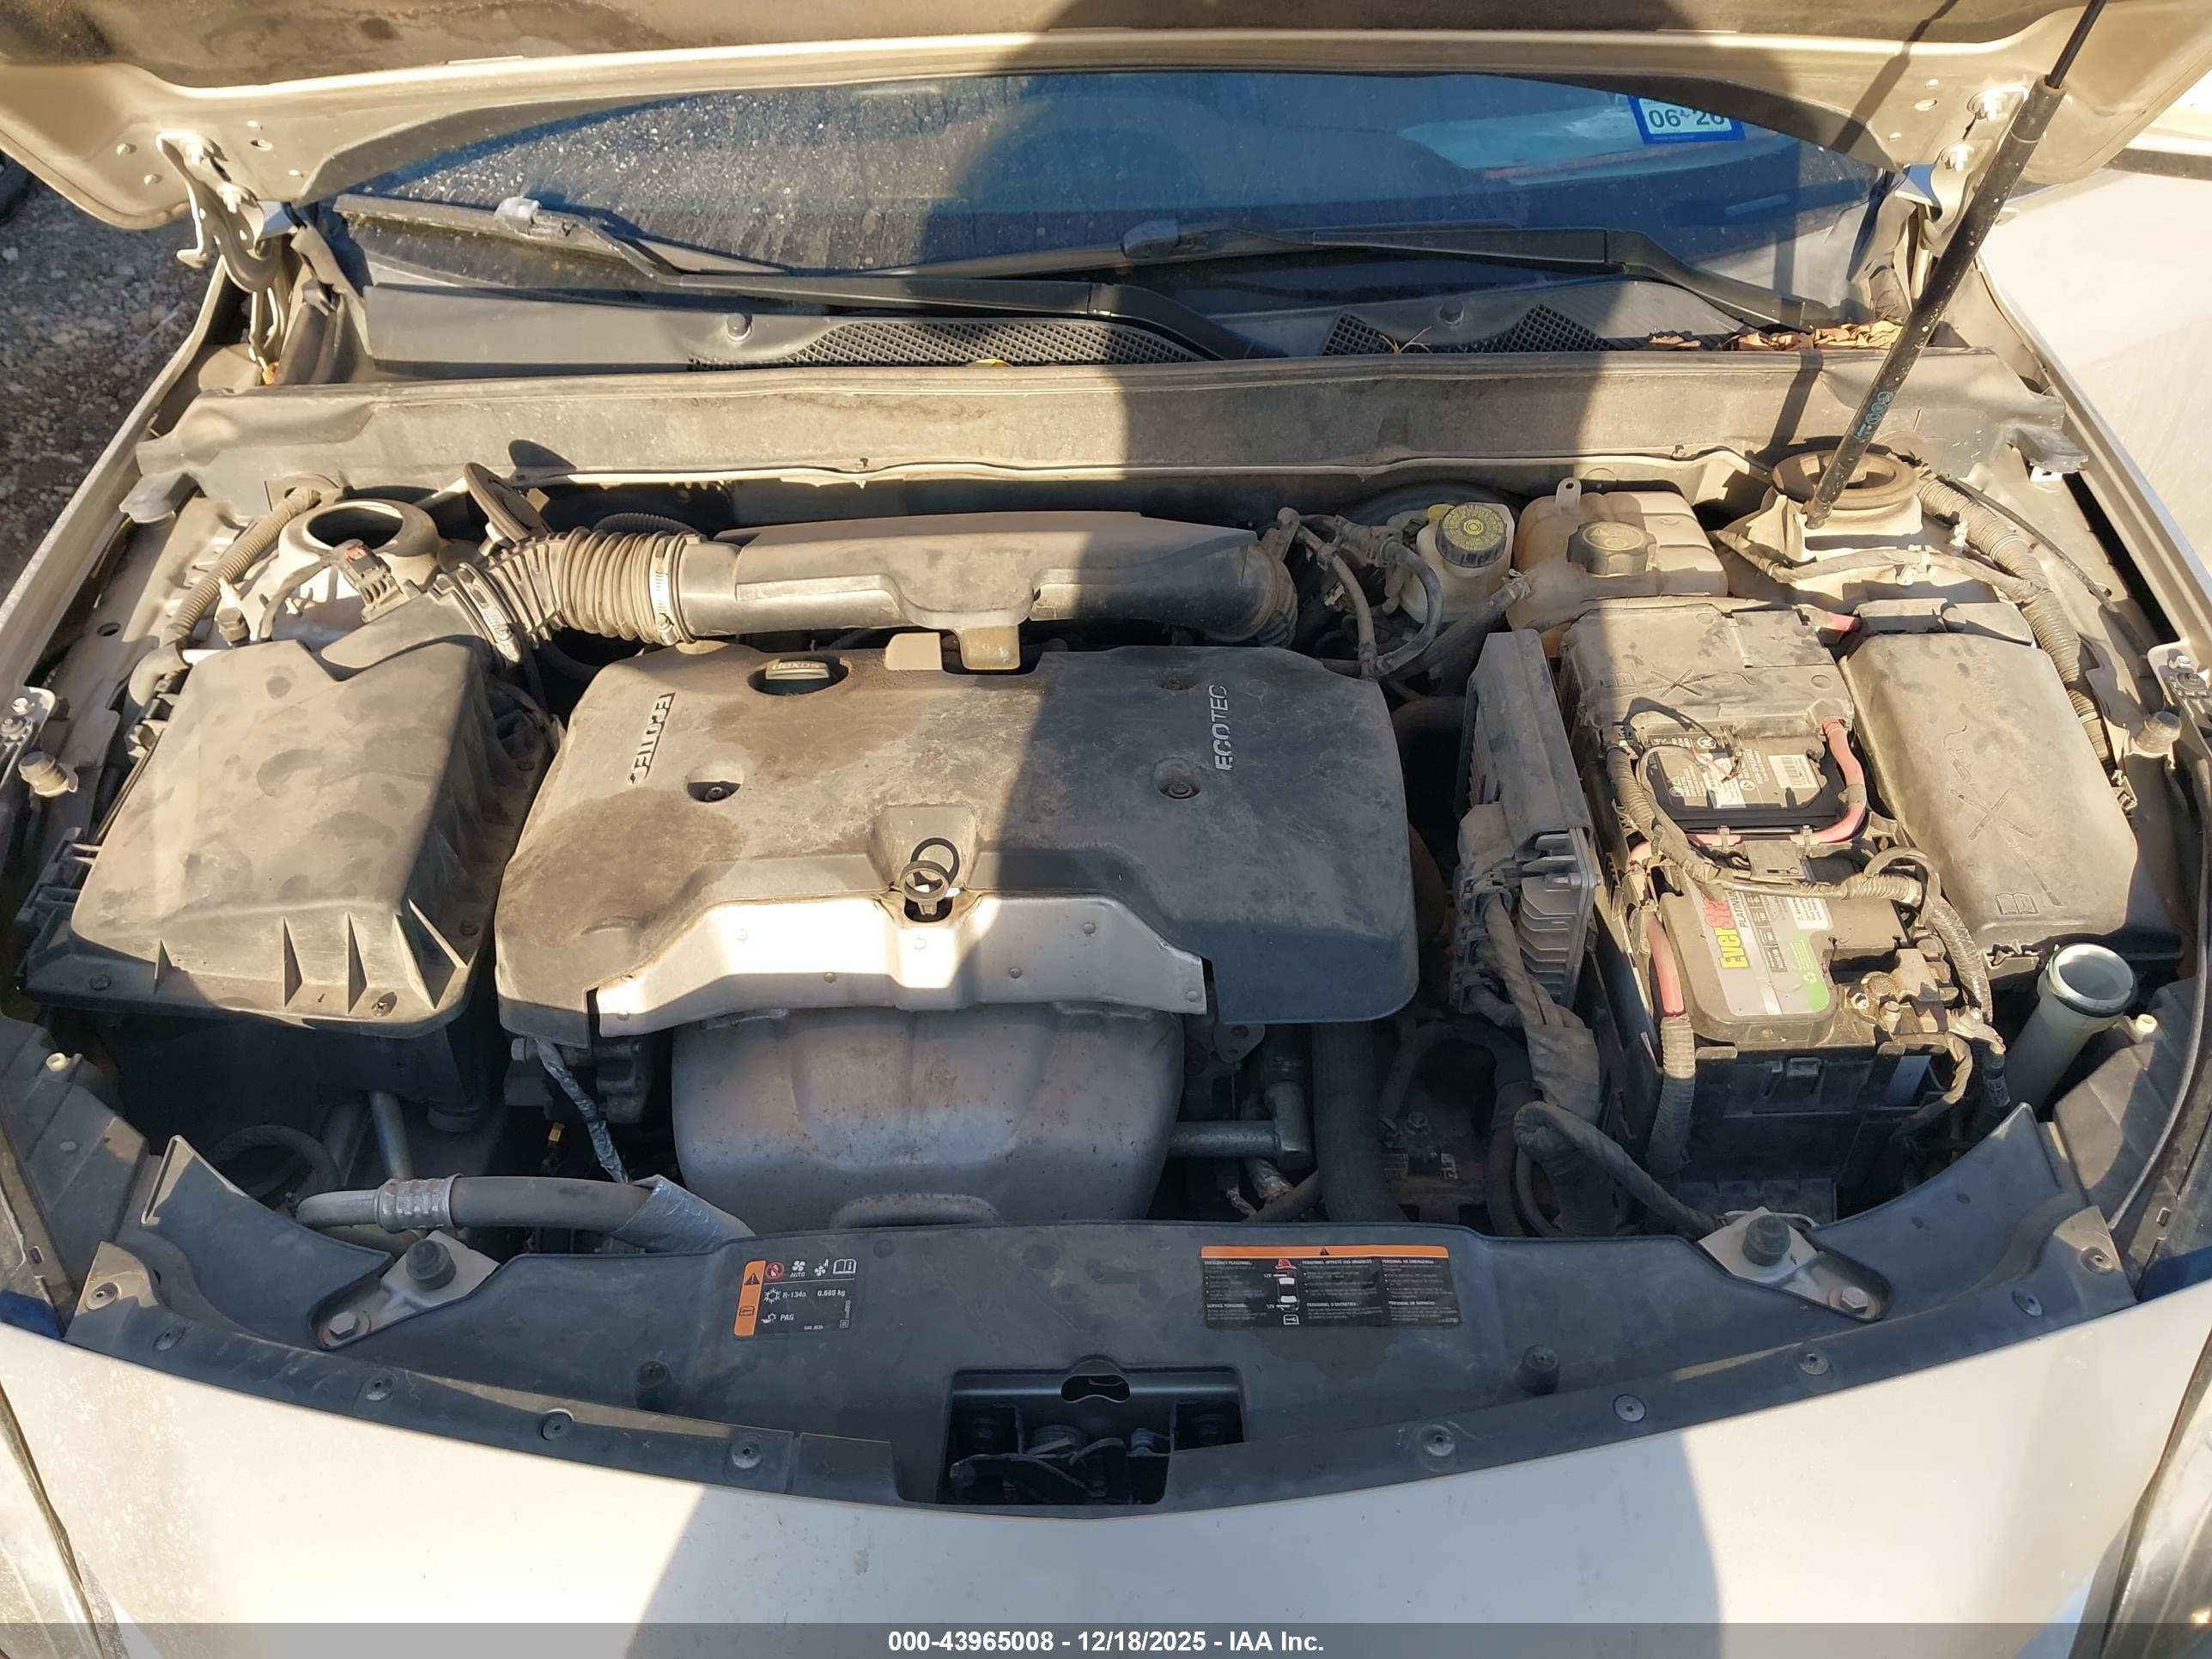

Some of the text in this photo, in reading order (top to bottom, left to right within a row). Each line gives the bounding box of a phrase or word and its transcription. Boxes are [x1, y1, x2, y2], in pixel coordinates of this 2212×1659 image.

[1648, 109, 1681, 128] 06
[1208, 684, 1234, 771] ECOTEC
[1703, 897, 1749, 969] EverSta
